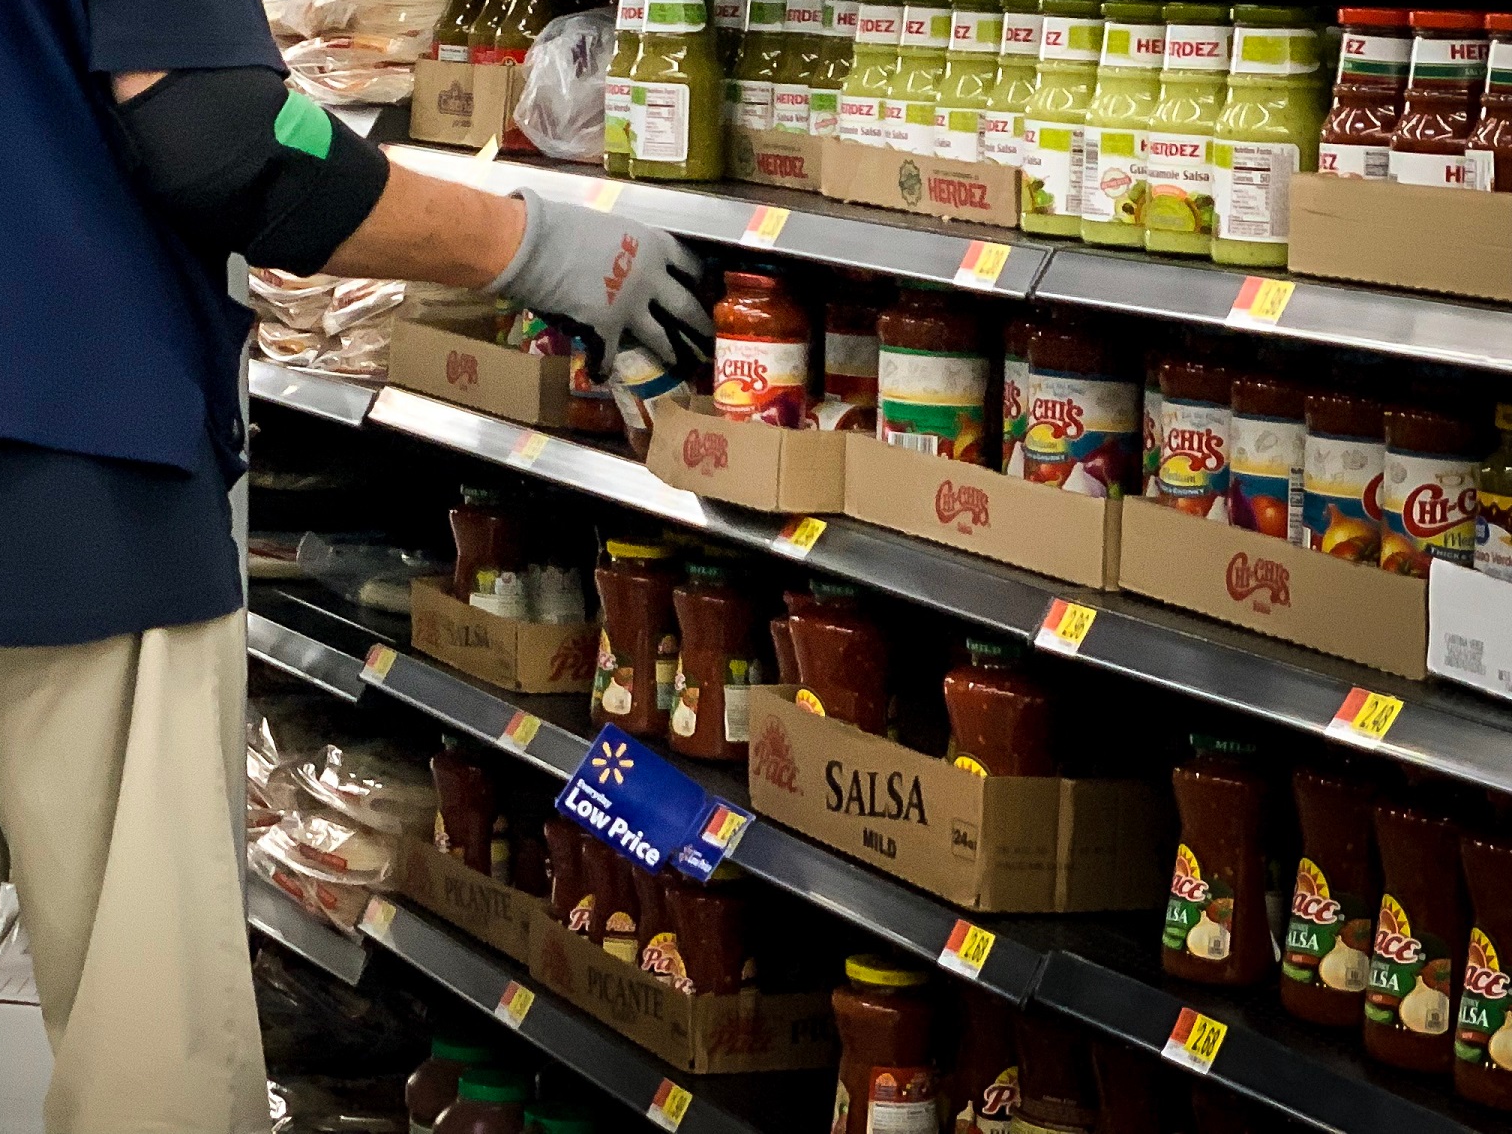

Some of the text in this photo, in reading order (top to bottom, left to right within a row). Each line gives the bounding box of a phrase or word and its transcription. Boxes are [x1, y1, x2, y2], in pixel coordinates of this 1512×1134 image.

[860, 127, 882, 137] Salsa
[996, 142, 1017, 154] Salsa
[757, 152, 808, 179] HERDEZ
[1182, 169, 1210, 182] Salsa
[928, 177, 991, 210] HERDEZ
[936, 479, 992, 526] CHI-CHI'S
[1430, 546, 1457, 558] THICK
[1226, 551, 1291, 608] CHI-CHI'S
[1214, 739, 1257, 754] MILD
[824, 759, 930, 827] SALSA
[563, 784, 612, 830] Low
[606, 816, 661, 867] Price
[862, 826, 898, 859] MILD
[588, 968, 666, 1021] PICANTE
[1188, 1025, 1219, 1058] 2.68
